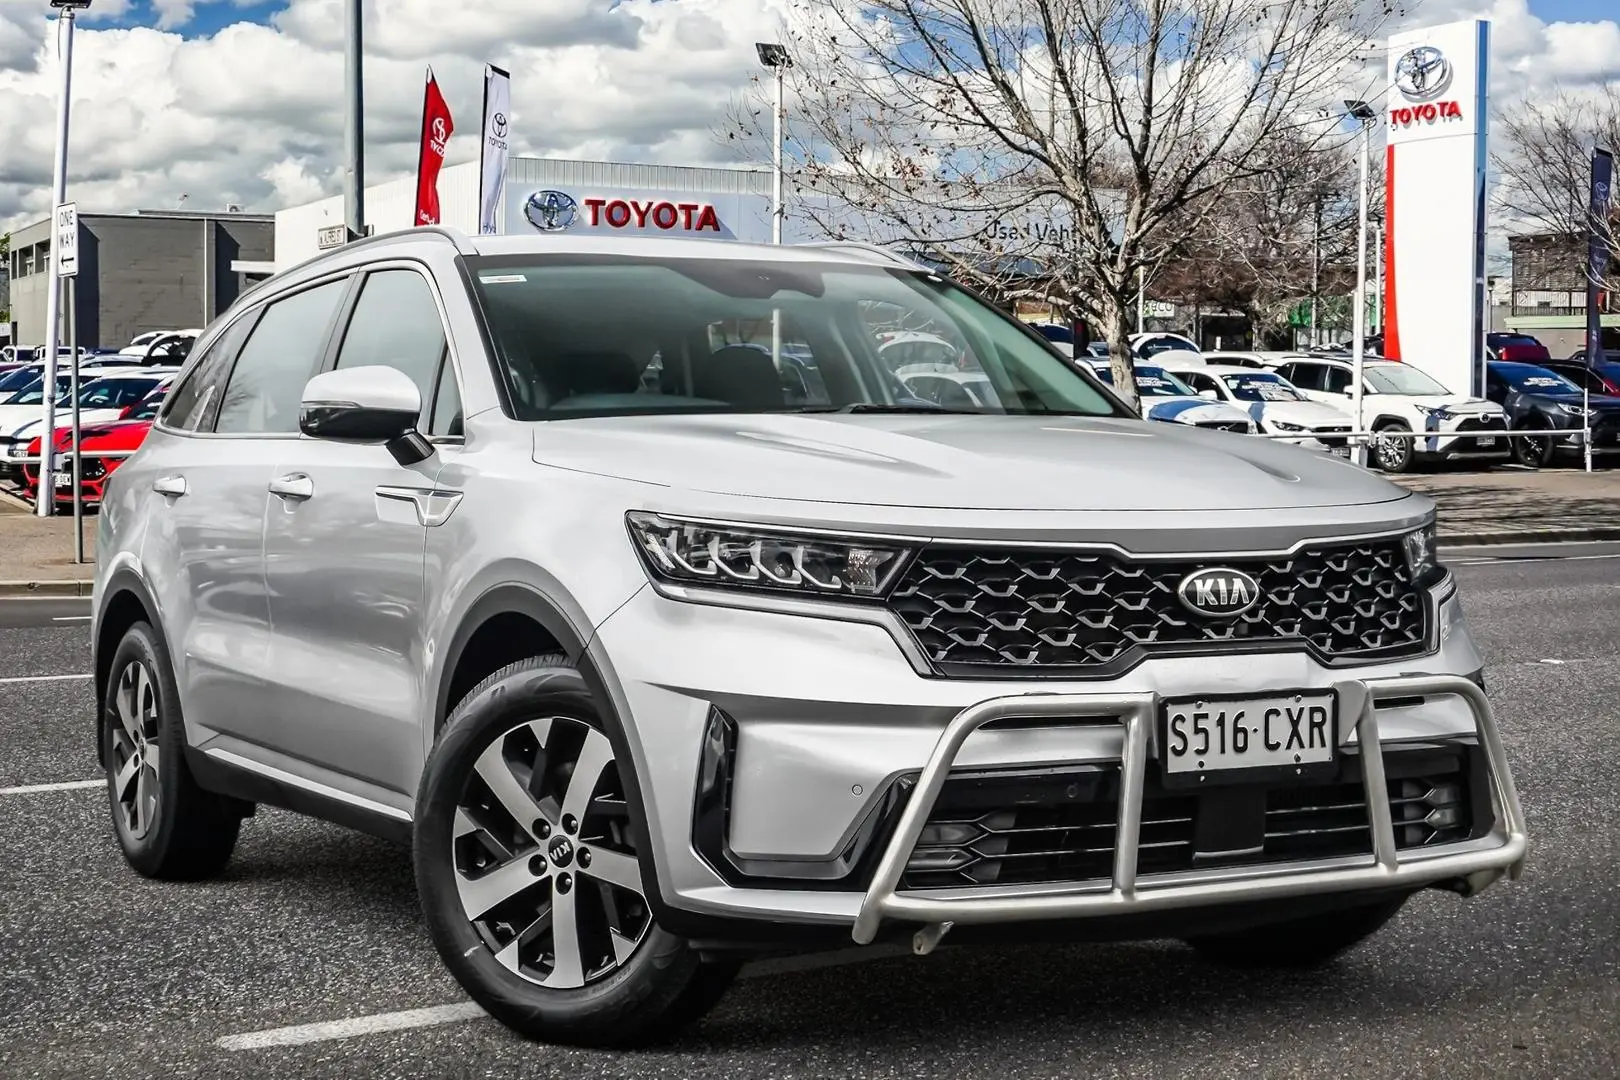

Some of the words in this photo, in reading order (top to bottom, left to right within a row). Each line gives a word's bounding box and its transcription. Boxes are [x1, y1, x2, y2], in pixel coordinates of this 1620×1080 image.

[1389, 101, 1462, 125] TOYOTA
[488, 136, 508, 151] TOYOTA
[59, 209, 75, 228] ONE
[584, 198, 721, 232] TOYOTA
[59, 231, 76, 248] WAY
[985, 220, 1030, 240] Used
[1193, 577, 1250, 606] KIA
[549, 841, 571, 861] KIA
